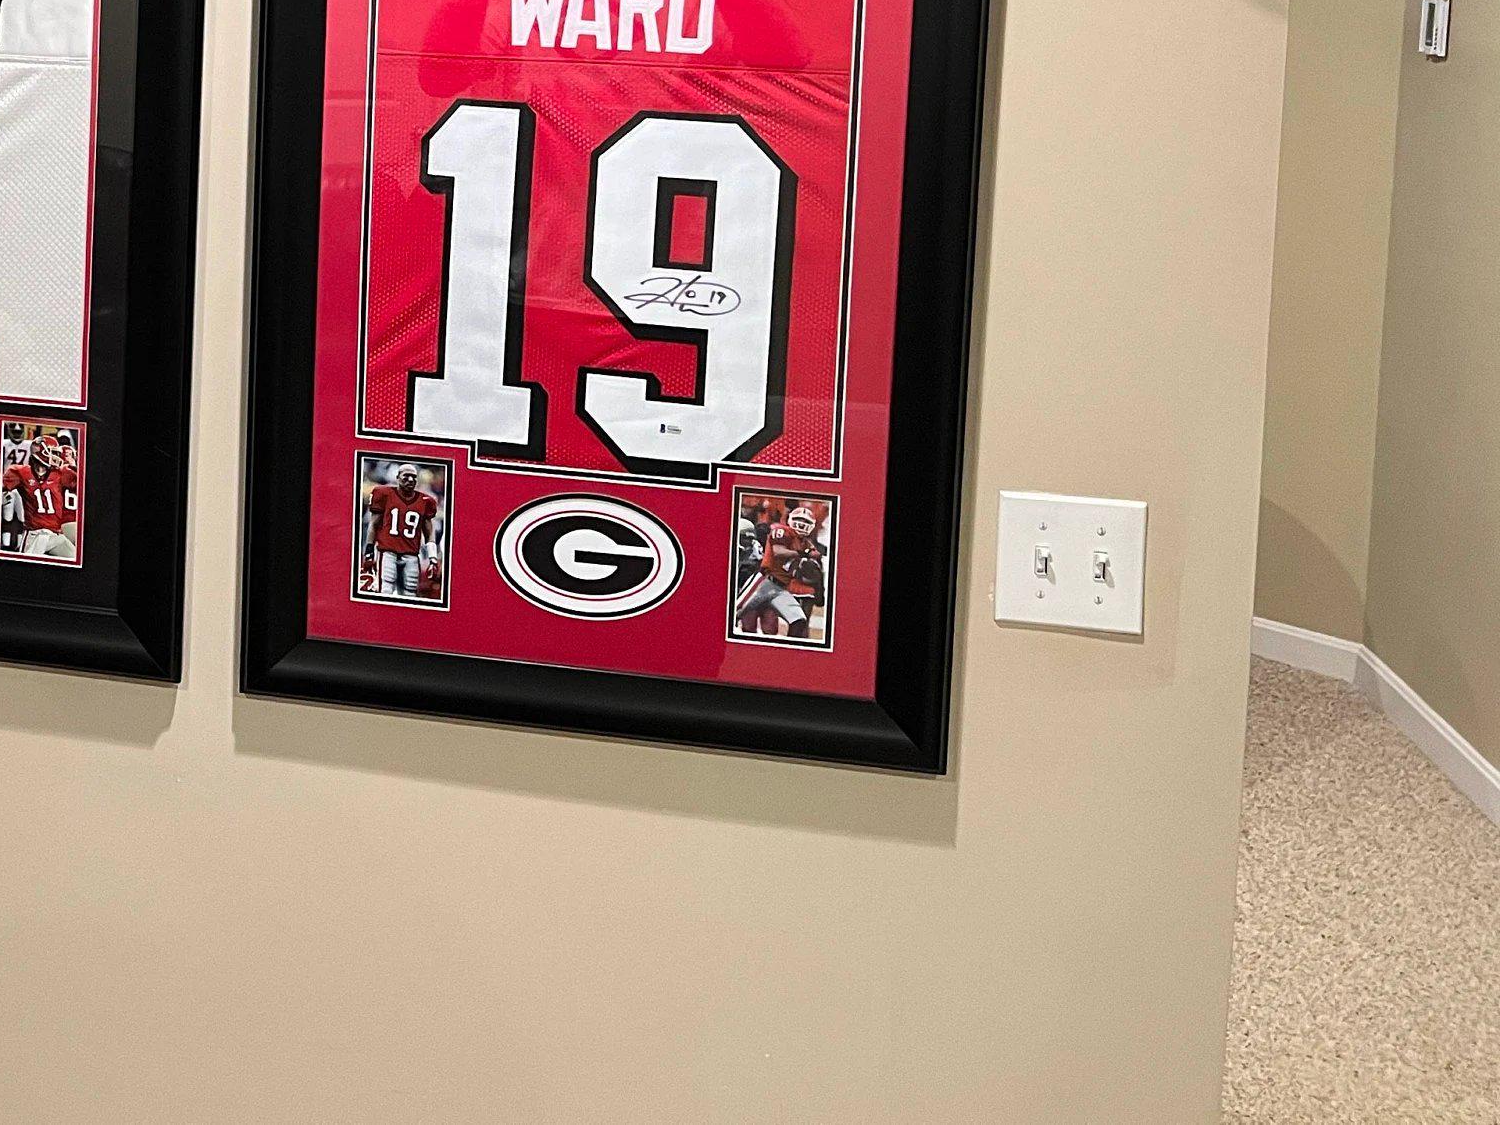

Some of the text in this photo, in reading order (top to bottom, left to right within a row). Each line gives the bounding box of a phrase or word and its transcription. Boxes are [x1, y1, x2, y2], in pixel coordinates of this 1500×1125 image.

[406, 98, 799, 474] 19
[34, 487, 56, 514] 11
[389, 506, 421, 539] 19
[521, 514, 656, 597] G
